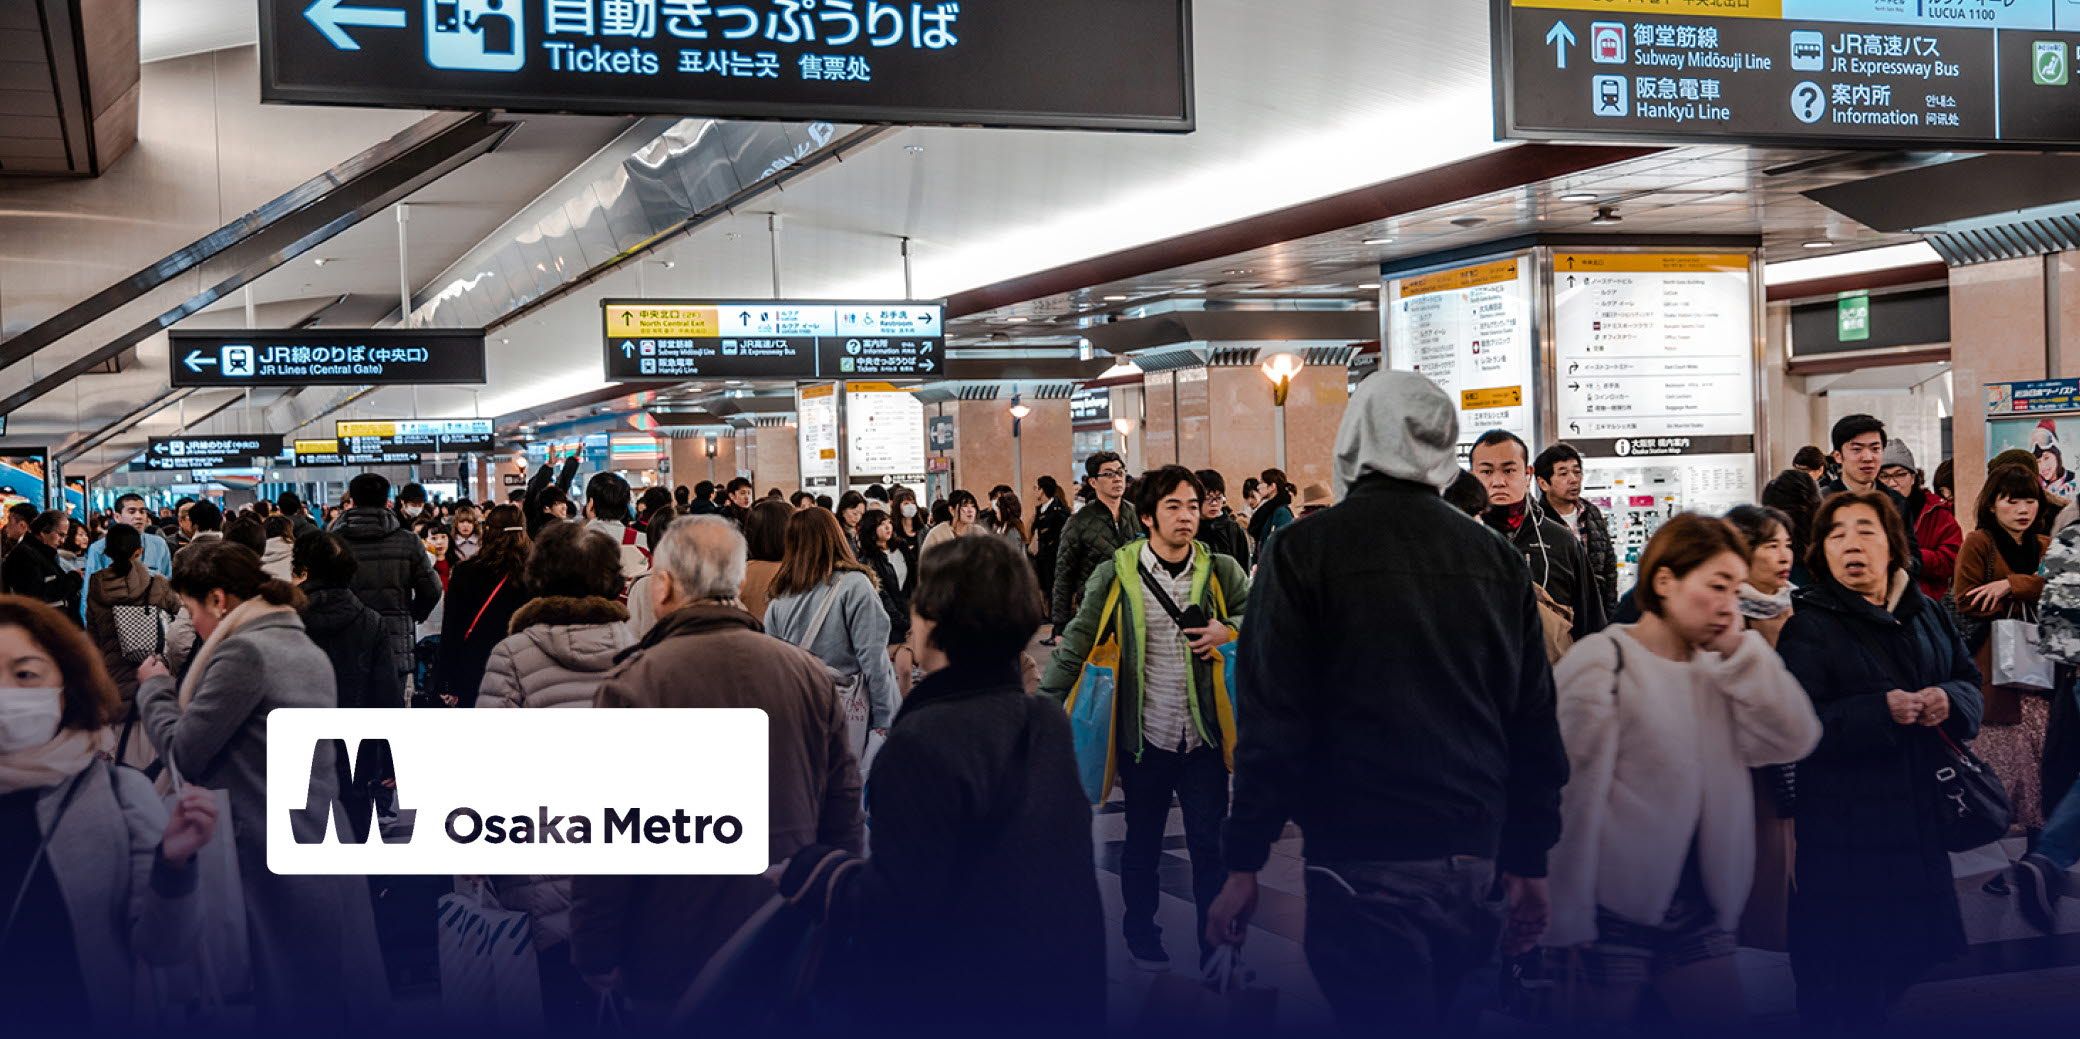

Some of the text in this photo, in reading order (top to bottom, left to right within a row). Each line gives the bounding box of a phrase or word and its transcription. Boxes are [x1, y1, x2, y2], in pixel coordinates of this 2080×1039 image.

[546, 0, 960, 49] 自動きっぷうりば
[1929, 8, 1995, 20] LUCUA 1100
[1633, 23, 1719, 49] 御堂筋線
[1831, 34, 1940, 57] JR高速バス
[543, 42, 658, 74] Tickets
[677, 50, 780, 79] 표사는곳
[797, 54, 871, 81] 售票处
[1634, 49, 1771, 72] Subway Midōsuji Line
[1831, 58, 1959, 79] JR Expressway Bus
[1635, 77, 1720, 101] 阪急電車
[1831, 84, 1891, 107] 案内所
[1636, 102, 1730, 123] Hankyū Line
[1832, 109, 1918, 126] Information
[260, 363, 383, 376] JR Lines (Central Gate)
